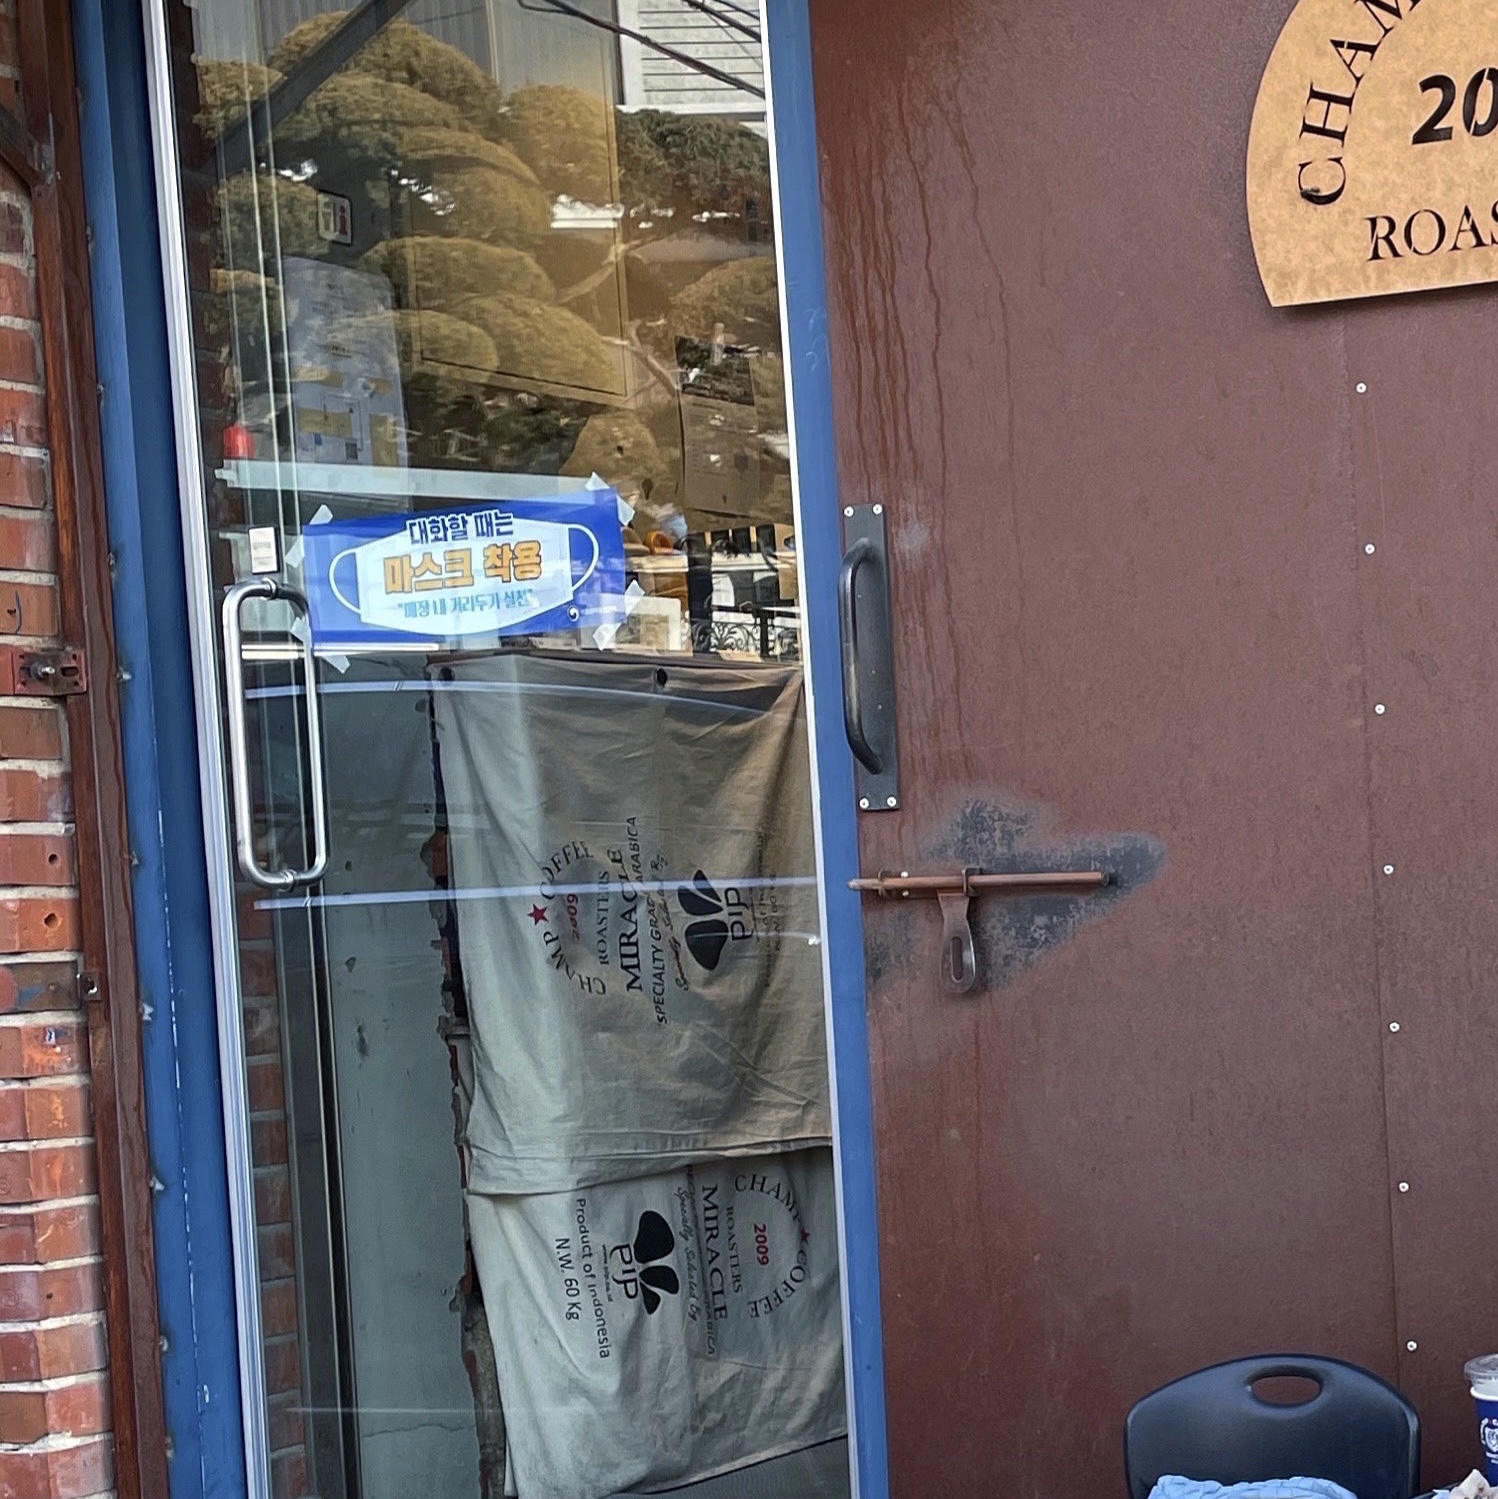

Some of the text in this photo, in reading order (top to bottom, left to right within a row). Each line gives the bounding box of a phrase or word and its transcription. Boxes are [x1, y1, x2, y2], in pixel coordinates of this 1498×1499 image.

[383, 539, 542, 595] 마스크 착용
[407, 510, 514, 545] 대화할 때는
[595, 870, 611, 965] ROASTERS
[606, 848, 643, 993] MIRACLE
[649, 944, 669, 1025] SPECIALTY
[555, 1237, 582, 1321] N.W. 60 Kg
[575, 1198, 613, 1358] Product of Indonesia
[701, 1183, 728, 1322] MIRACLE
[725, 1206, 744, 1294] ROASTERS
[748, 1249, 808, 1319] COFFEE
[753, 1223, 770, 1266] 2009
